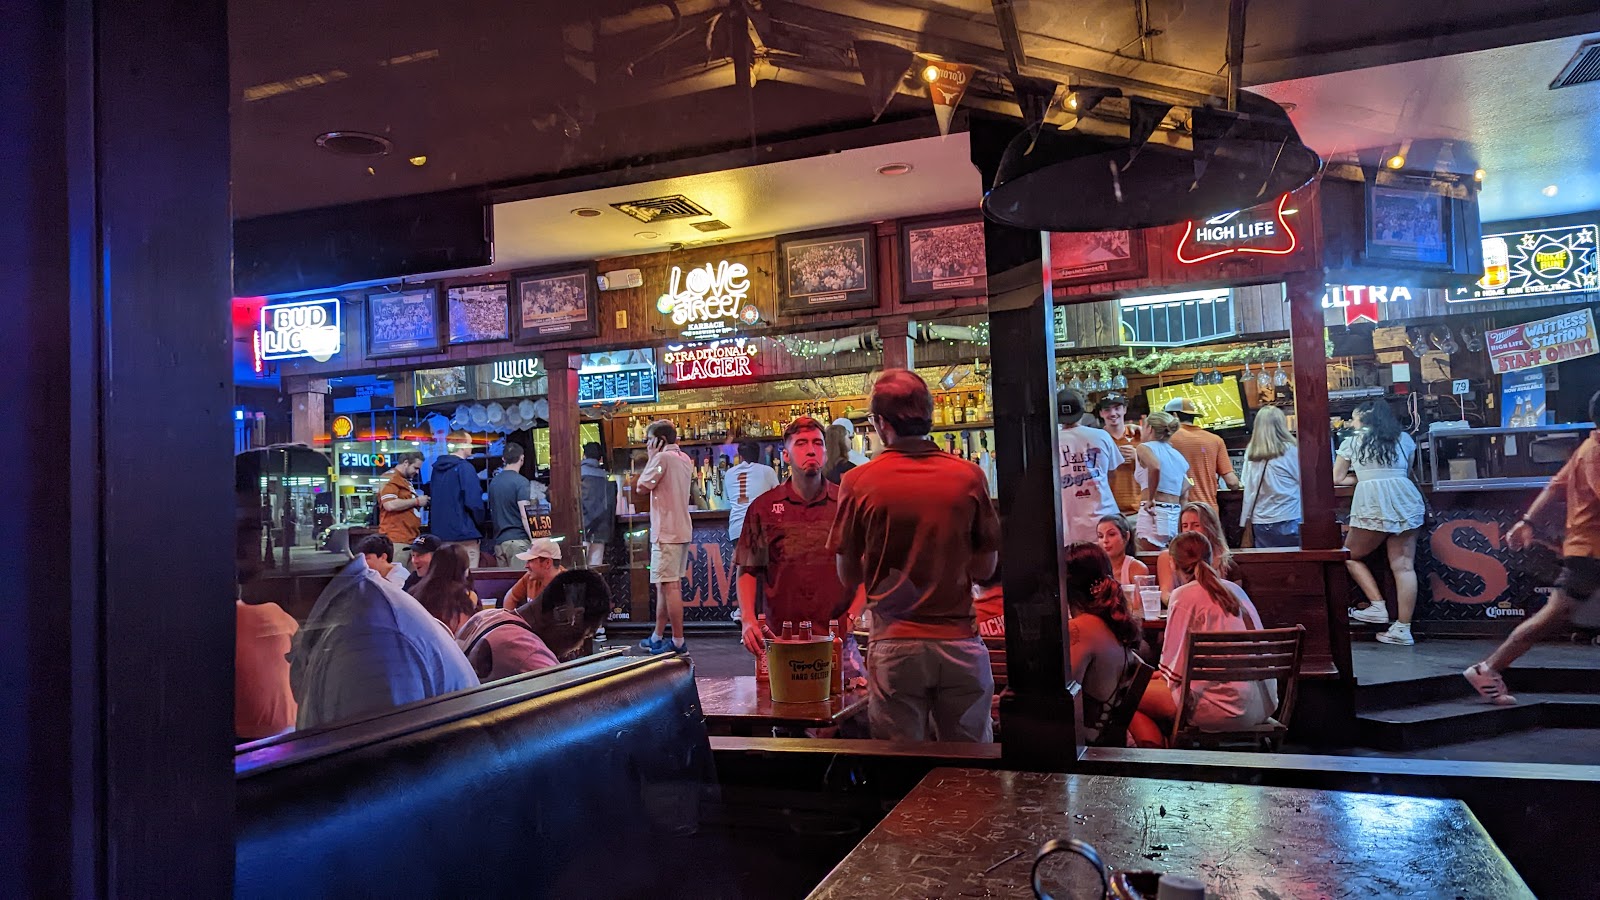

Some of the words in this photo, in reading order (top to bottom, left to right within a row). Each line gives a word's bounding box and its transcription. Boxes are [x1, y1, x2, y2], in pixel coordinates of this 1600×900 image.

[1196, 225, 1235, 242] HIGH
[1238, 221, 1275, 239] LIFE
[1536, 251, 1567, 263] HOME
[1482, 289, 1505, 297] HOME
[1525, 285, 1549, 293] EVERY
[273, 305, 327, 332] BUD
[1490, 328, 1519, 344] Miller
[1491, 343, 1508, 351] HIGH
[1508, 340, 1523, 348] LIFE
[674, 346, 748, 362] TRADITIONAL
[1498, 350, 1541, 371] STAFF
[1546, 338, 1593, 362] ONLY!
[675, 356, 752, 381] LAGER
[1455, 382, 1466, 391] 79
[737, 472, 749, 504] 1
[529, 516, 552, 530] $1.50
[607, 611, 630, 621] Corona
[1486, 606, 1525, 618] Corona
